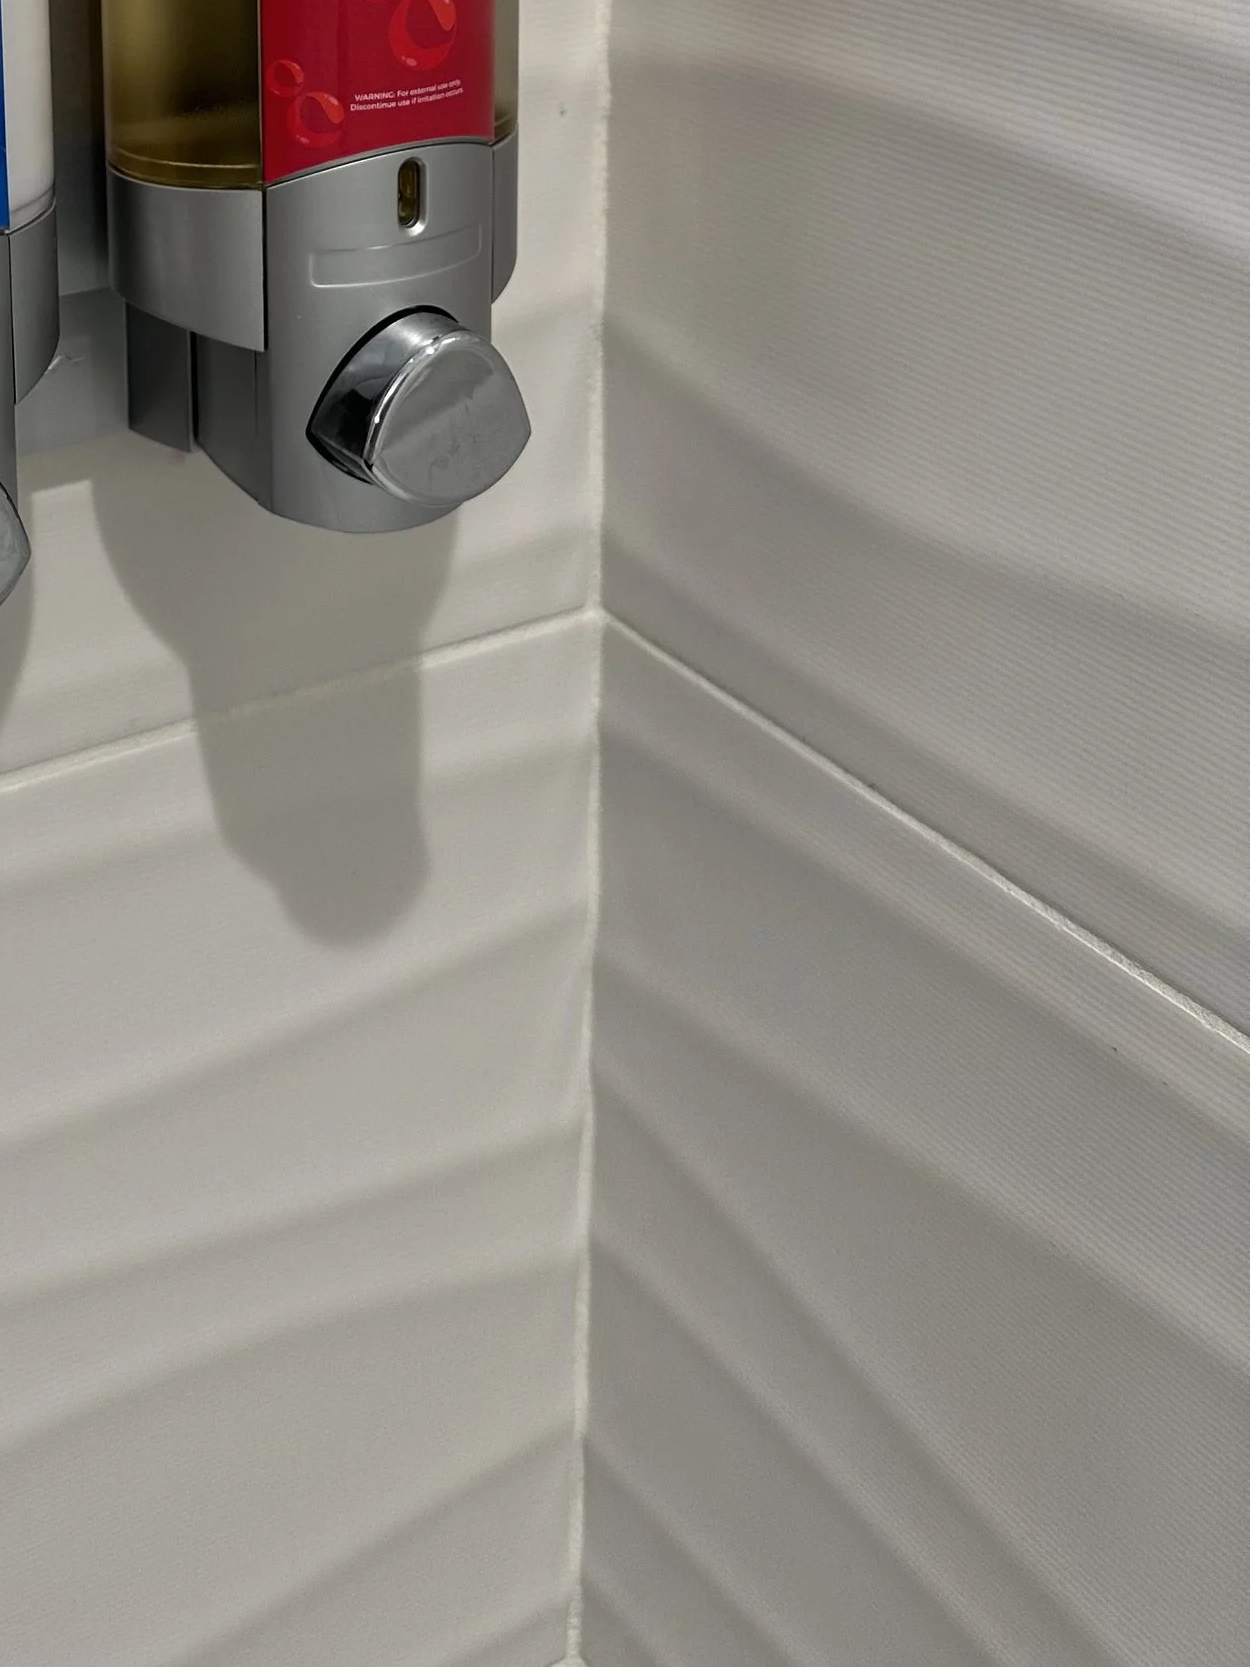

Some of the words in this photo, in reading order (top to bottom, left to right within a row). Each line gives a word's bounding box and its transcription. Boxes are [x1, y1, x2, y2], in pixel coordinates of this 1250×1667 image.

[410, 84, 437, 95] external
[351, 101, 396, 111] Discontinue
[418, 92, 444, 103] irritation
